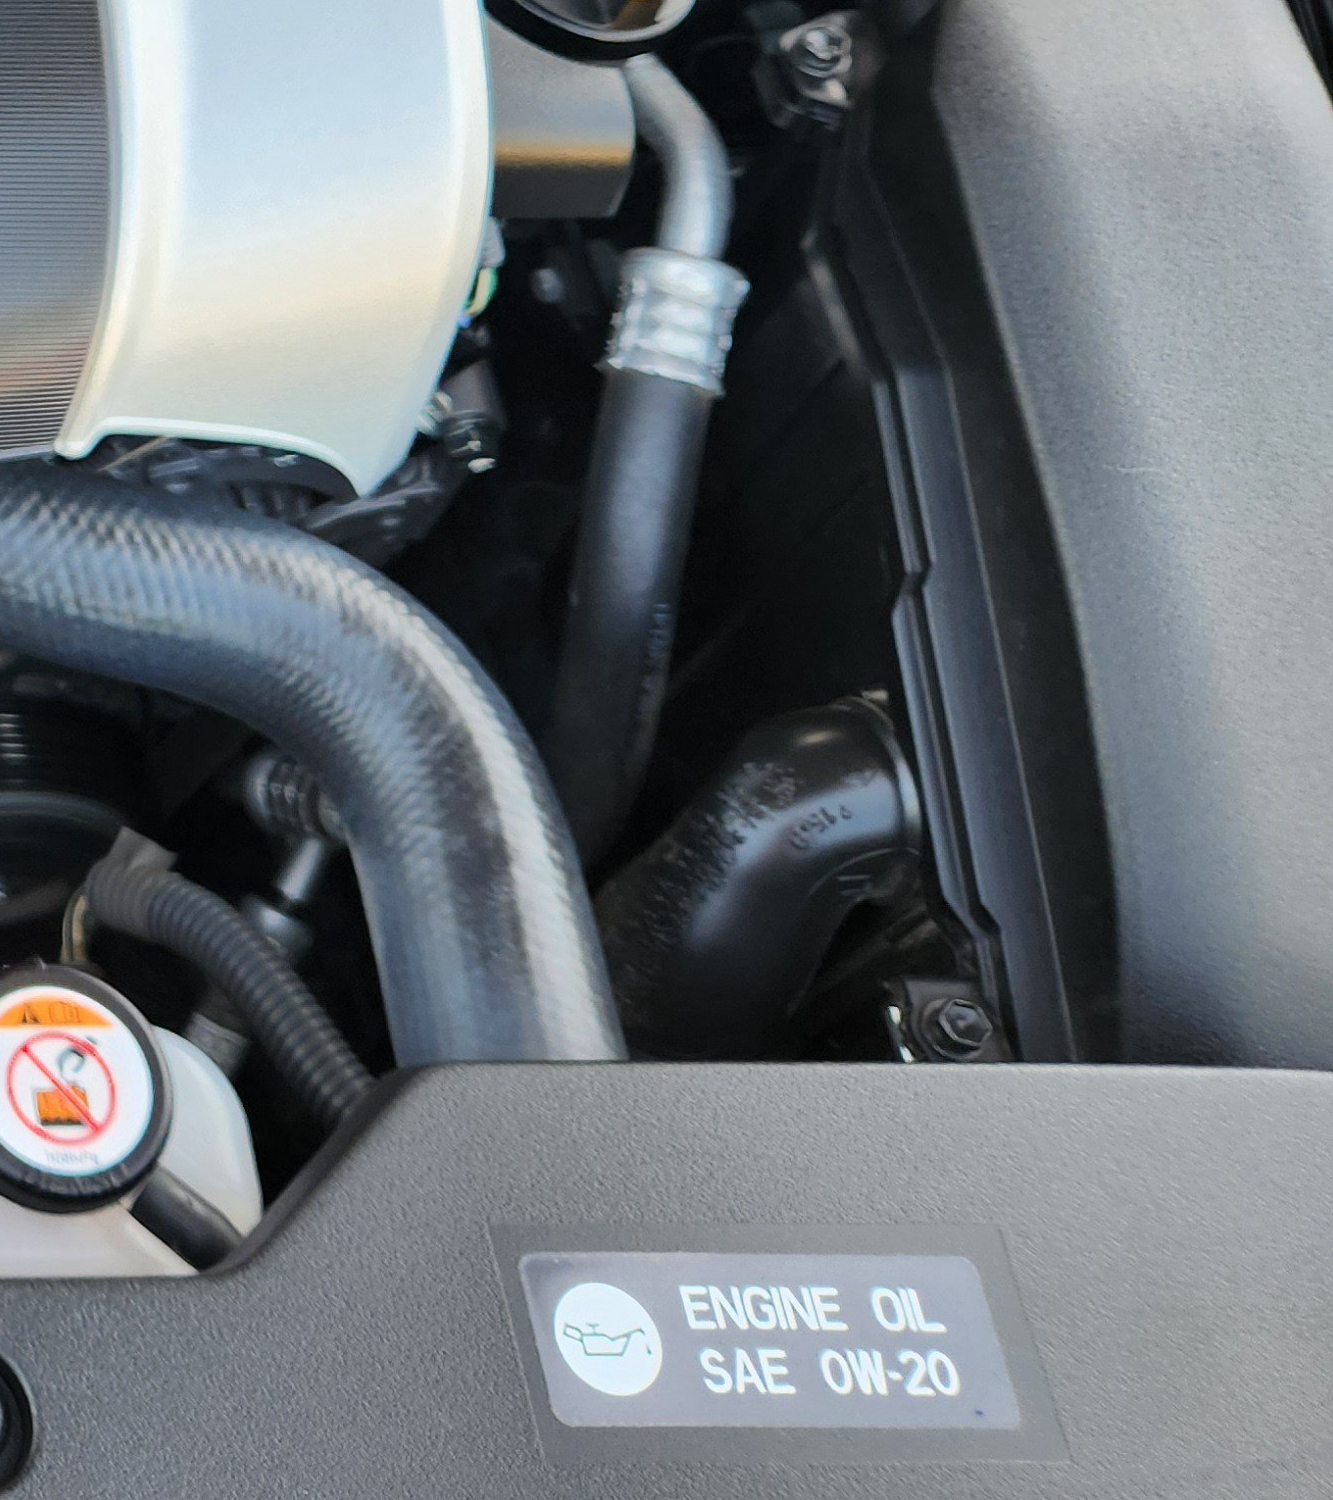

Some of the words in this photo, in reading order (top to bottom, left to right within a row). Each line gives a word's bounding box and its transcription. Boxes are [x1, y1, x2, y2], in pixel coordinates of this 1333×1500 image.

[679, 1284, 849, 1331] ENGINE
[870, 1286, 947, 1333] OIL
[699, 1347, 797, 1395] SAE
[820, 1348, 961, 1397] 0W-20
